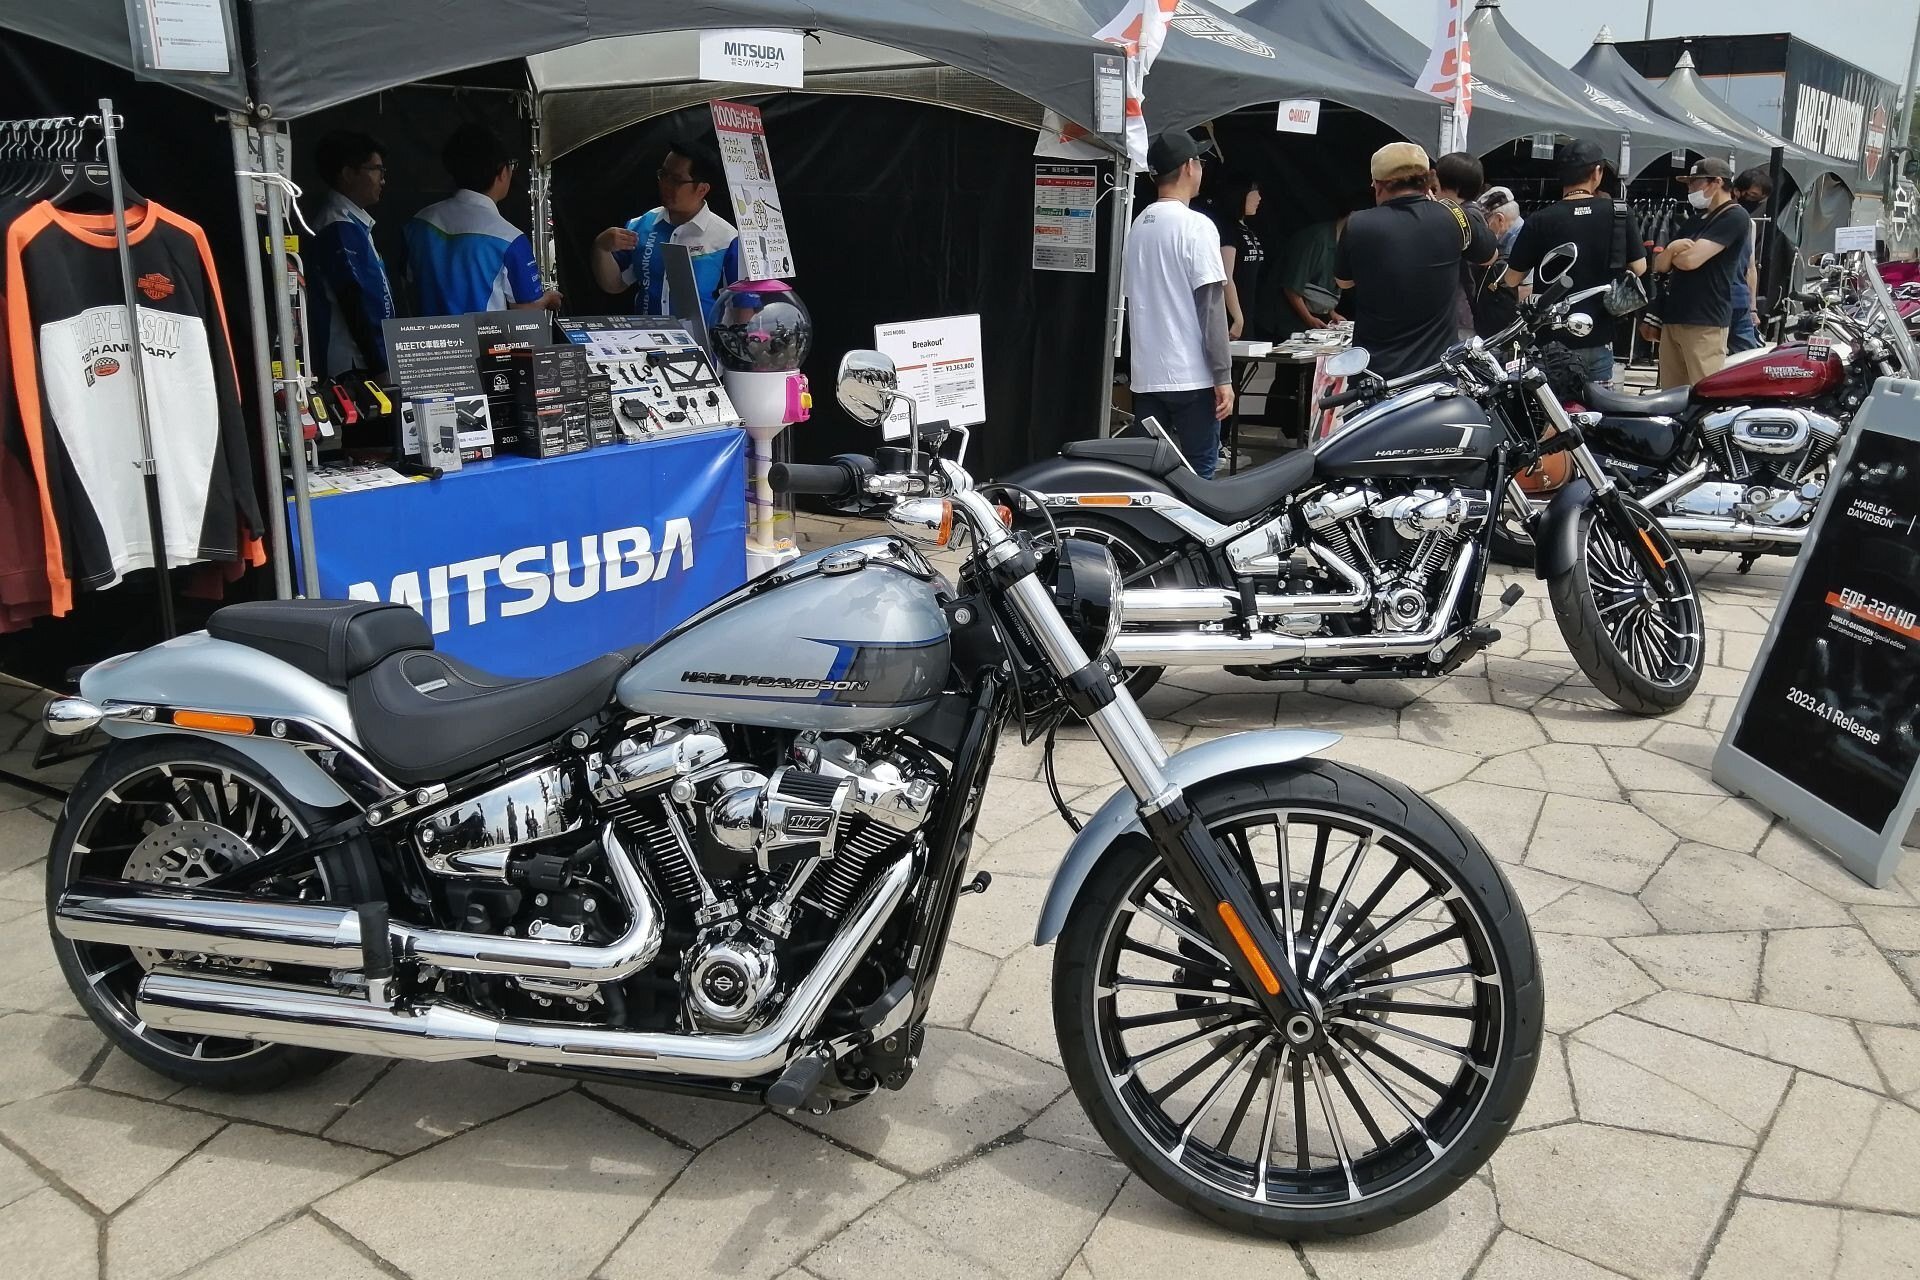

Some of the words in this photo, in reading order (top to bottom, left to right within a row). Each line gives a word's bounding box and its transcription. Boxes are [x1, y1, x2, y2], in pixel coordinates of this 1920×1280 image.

[724, 41, 785, 61] MITSUBA
[1452, 207, 1468, 229] Nikon
[1605, 458, 1639, 471] PLEASURE
[1846, 508, 1894, 529] DAVIDSON
[347, 517, 694, 634] MITSUBA
[681, 671, 869, 691] HARLEY-DAVIDSON
[1786, 686, 1832, 724] 2023.4.1
[1831, 708, 1881, 745] Release
[788, 814, 831, 830] 117
